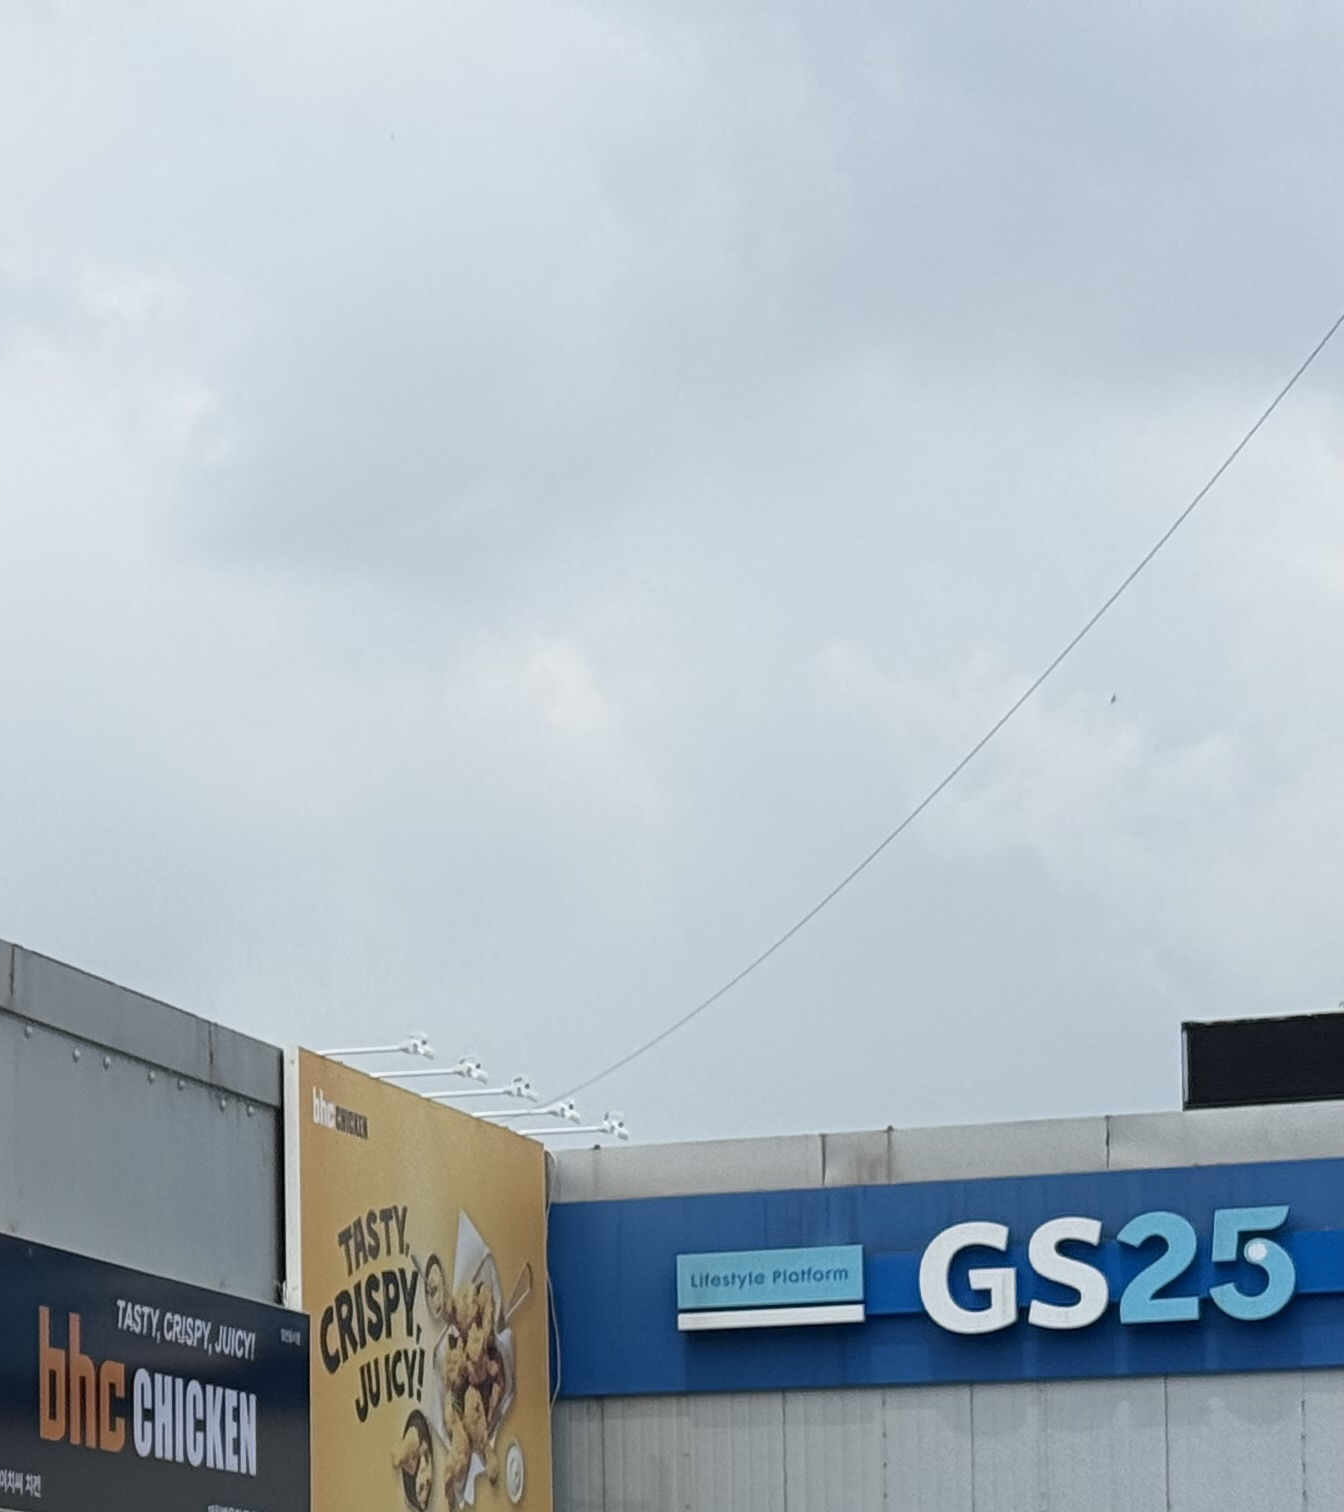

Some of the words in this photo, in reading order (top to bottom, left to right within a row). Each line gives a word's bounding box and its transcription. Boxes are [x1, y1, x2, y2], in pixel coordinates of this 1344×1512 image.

[338, 1205, 410, 1278] TASTY,
[690, 1269, 765, 1289] Lifestyle
[772, 1264, 850, 1285] Platform
[918, 1205, 1297, 1335] GS25
[116, 1300, 160, 1345] TASTY,
[163, 1312, 212, 1357] CRISPY,
[214, 1327, 256, 1361] JUICY!
[319, 1268, 422, 1375] CRISPY,
[38, 1306, 126, 1452] bhc
[132, 1366, 258, 1477] CHICKEN
[352, 1350, 425, 1423] JUICY!
